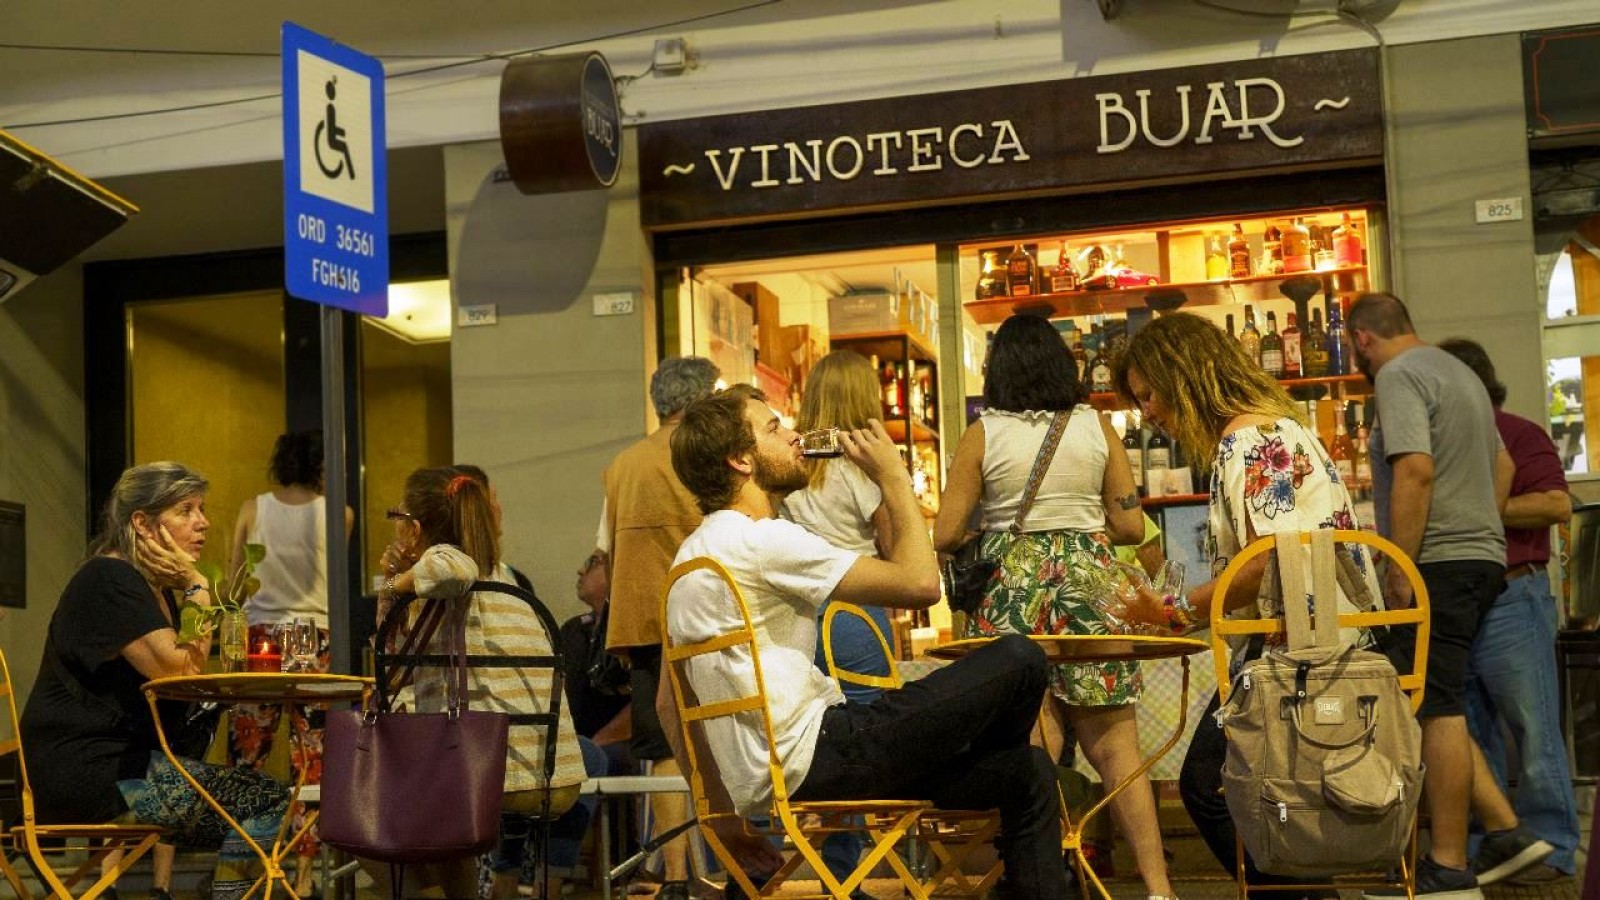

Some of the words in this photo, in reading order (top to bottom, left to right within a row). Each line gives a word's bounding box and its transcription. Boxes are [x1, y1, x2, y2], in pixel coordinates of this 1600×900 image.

[704, 119, 1031, 191] VINOTECA
[1095, 77, 1305, 154] BUAR
[1488, 204, 1512, 217] 825
[298, 213, 326, 244] ORD
[336, 224, 375, 257] 36561
[312, 258, 361, 294] FGH616
[611, 300, 631, 313] 827
